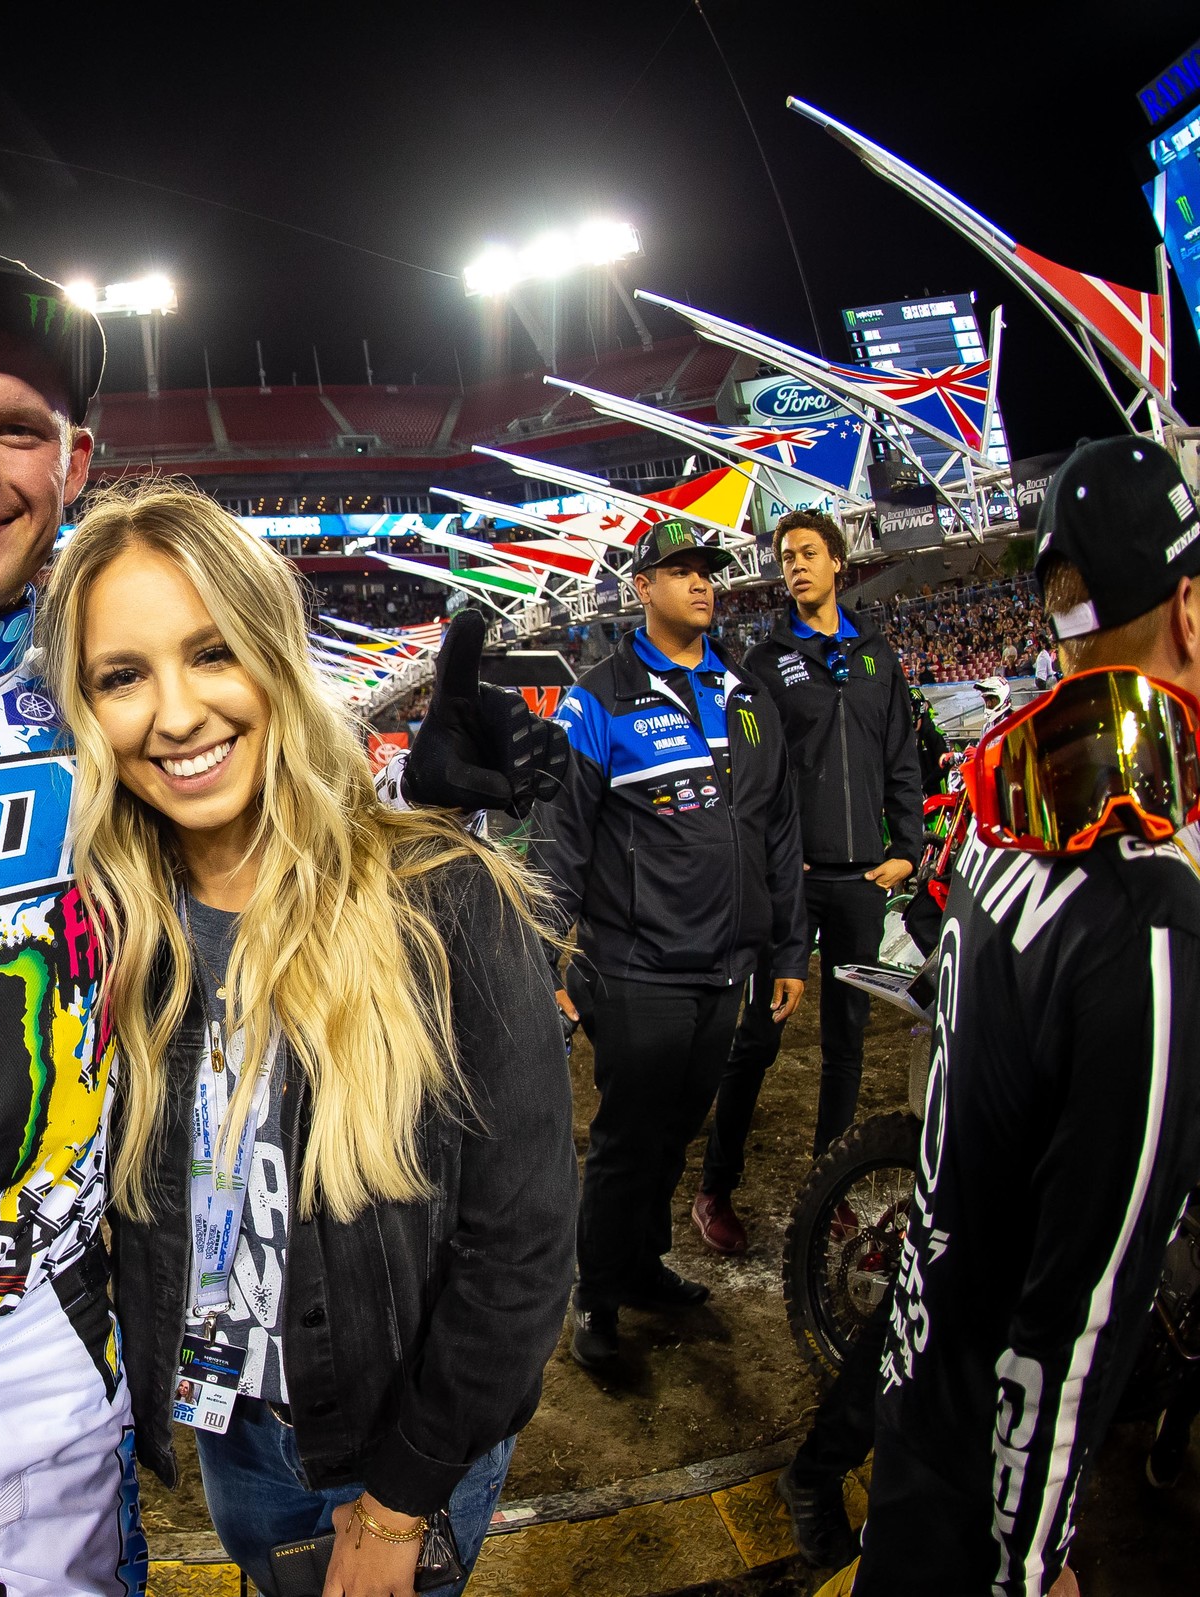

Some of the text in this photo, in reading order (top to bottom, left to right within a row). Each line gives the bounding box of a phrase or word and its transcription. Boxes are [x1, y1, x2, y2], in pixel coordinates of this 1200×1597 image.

[887, 509, 905, 520] ROCKY
[645, 713, 691, 730] YAMAHA
[653, 735, 688, 751] YAMALUBE
[216, 1209, 234, 1271] SUPERCROSS
[203, 1411, 226, 1428] FELD
